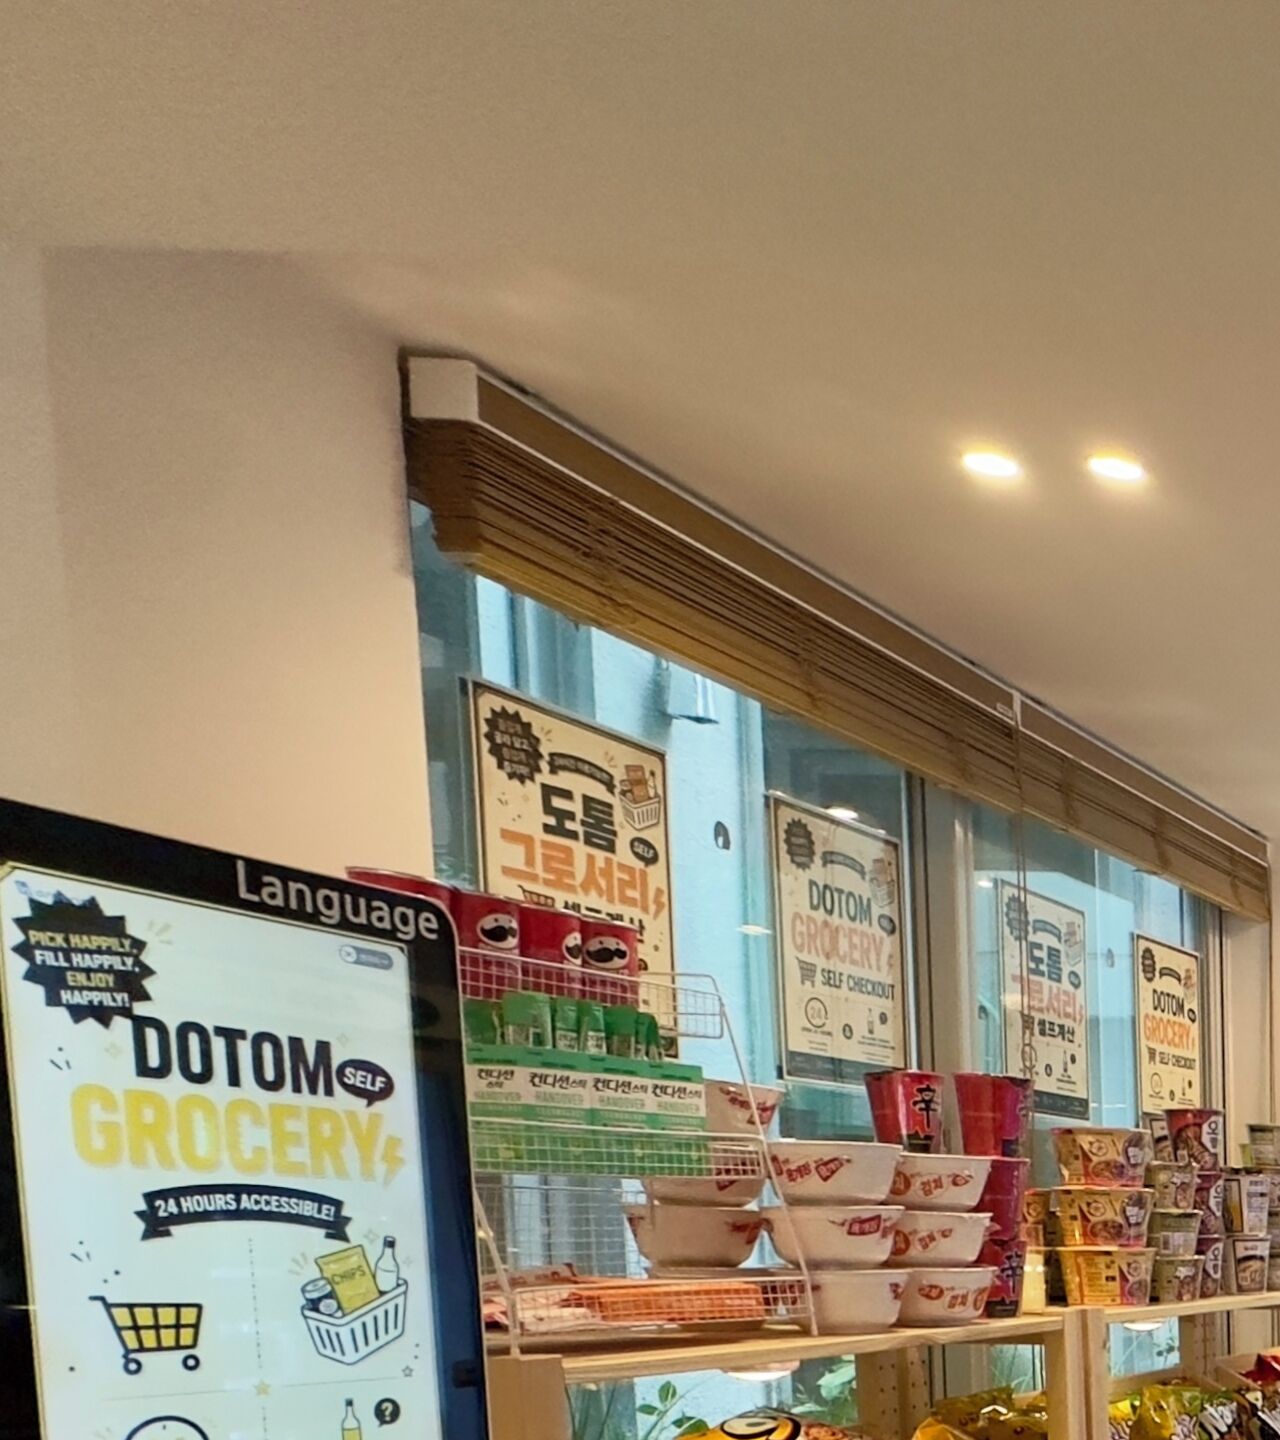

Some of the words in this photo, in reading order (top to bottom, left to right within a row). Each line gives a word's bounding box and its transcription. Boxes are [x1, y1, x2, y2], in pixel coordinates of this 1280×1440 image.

[540, 782, 620, 854] 도톰
[632, 842, 657, 862] SELF
[499, 829, 651, 918] 그로서리
[234, 859, 441, 941] Language
[808, 879, 873, 928] DOTOM
[28, 930, 67, 948] PICK
[790, 911, 887, 970] GROCERY
[34, 950, 70, 967] FILL
[72, 953, 140, 973] HAPPILY.
[1028, 940, 1063, 985] 도톰
[66, 970, 115, 988] ENJOY
[820, 968, 844, 989] SELF
[846, 974, 896, 1002] CHECKOUT
[60, 989, 131, 1008] HAPPILY!
[1152, 988, 1186, 1019] DOTOM
[1143, 1013, 1191, 1051] GROCERY
[132, 1014, 337, 1097] DOTOM
[342, 1068, 388, 1094] SELF
[528, 1072, 570, 1090] 컨디션
[592, 1077, 632, 1095] 컨디션
[651, 1083, 687, 1100] 컨디션
[69, 1083, 386, 1182] GROCERY
[155, 1198, 178, 1218] 24
[180, 1192, 237, 1215] HOURS
[239, 1194, 336, 1222] ACCESSIBLE!
[330, 1264, 368, 1288] CHIPS
